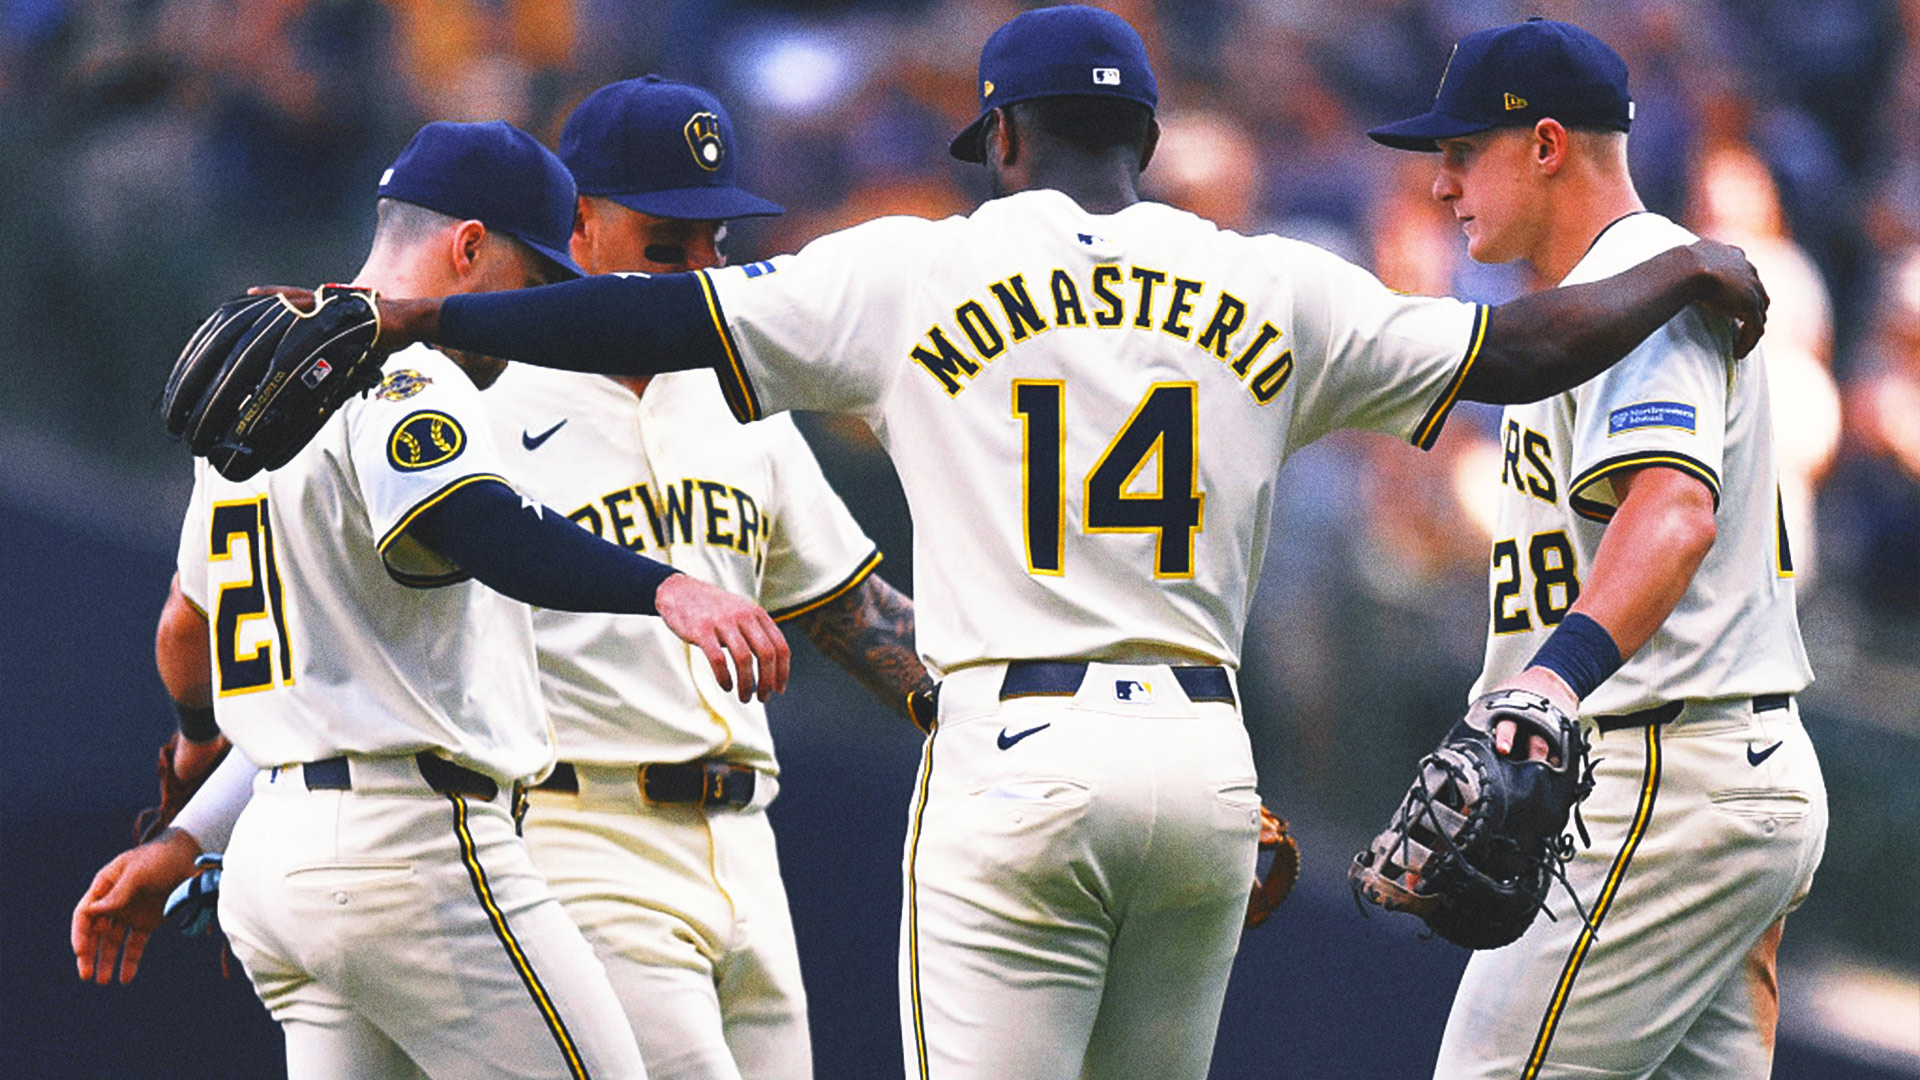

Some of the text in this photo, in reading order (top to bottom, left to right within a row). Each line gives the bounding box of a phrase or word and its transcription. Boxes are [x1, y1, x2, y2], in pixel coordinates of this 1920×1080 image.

[910, 263, 1295, 406] MONASTERIO
[566, 477, 770, 578] EWER
[1011, 377, 1206, 580] 14
[208, 492, 296, 698] 21
[1493, 528, 1580, 636] 28
